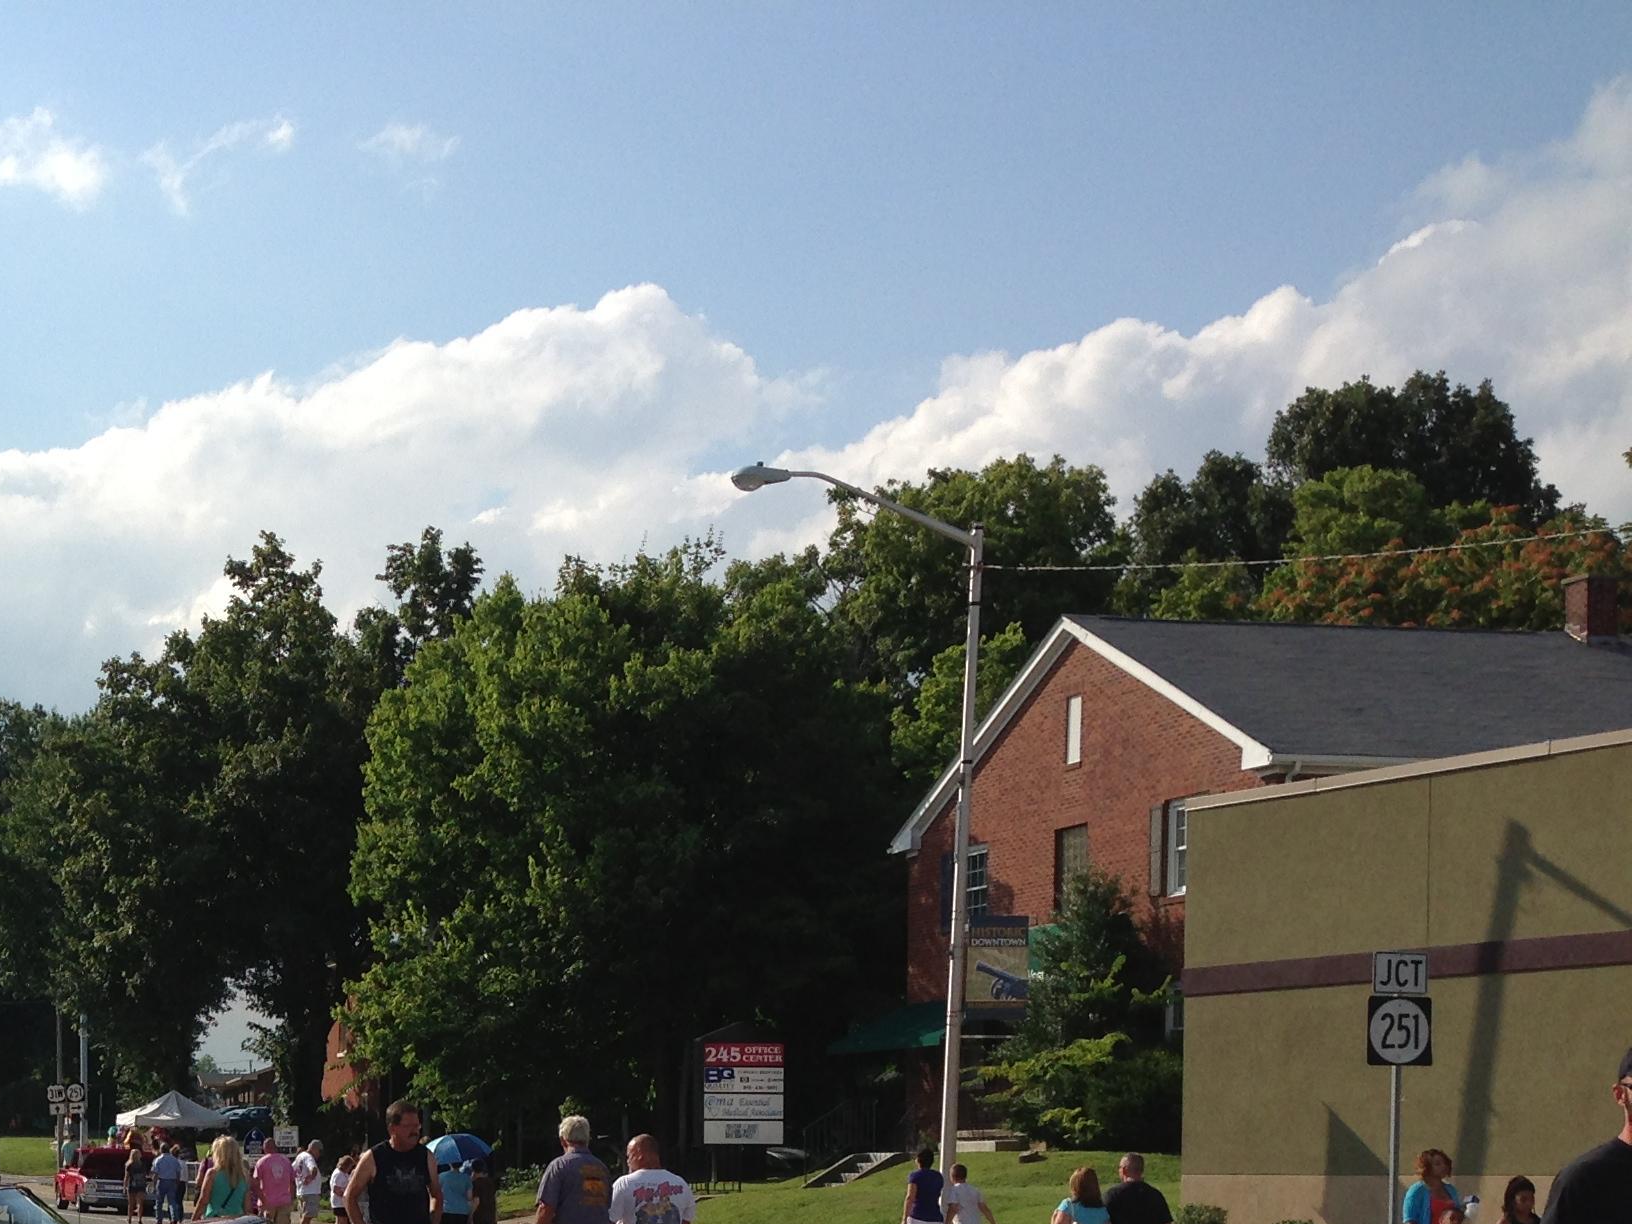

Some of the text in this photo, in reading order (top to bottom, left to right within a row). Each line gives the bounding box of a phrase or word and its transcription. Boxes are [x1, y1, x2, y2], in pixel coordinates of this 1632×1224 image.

[971, 927, 1026, 937] HISTORIC
[971, 938, 1026, 946] DOWNTOWN
[1379, 959, 1423, 988] JCT
[1380, 1012, 1420, 1050] 251
[705, 1046, 742, 1063] 245
[744, 1046, 782, 1054] OFFICE
[742, 1054, 783, 1063] CENTER
[69, 1087, 83, 1099] 251
